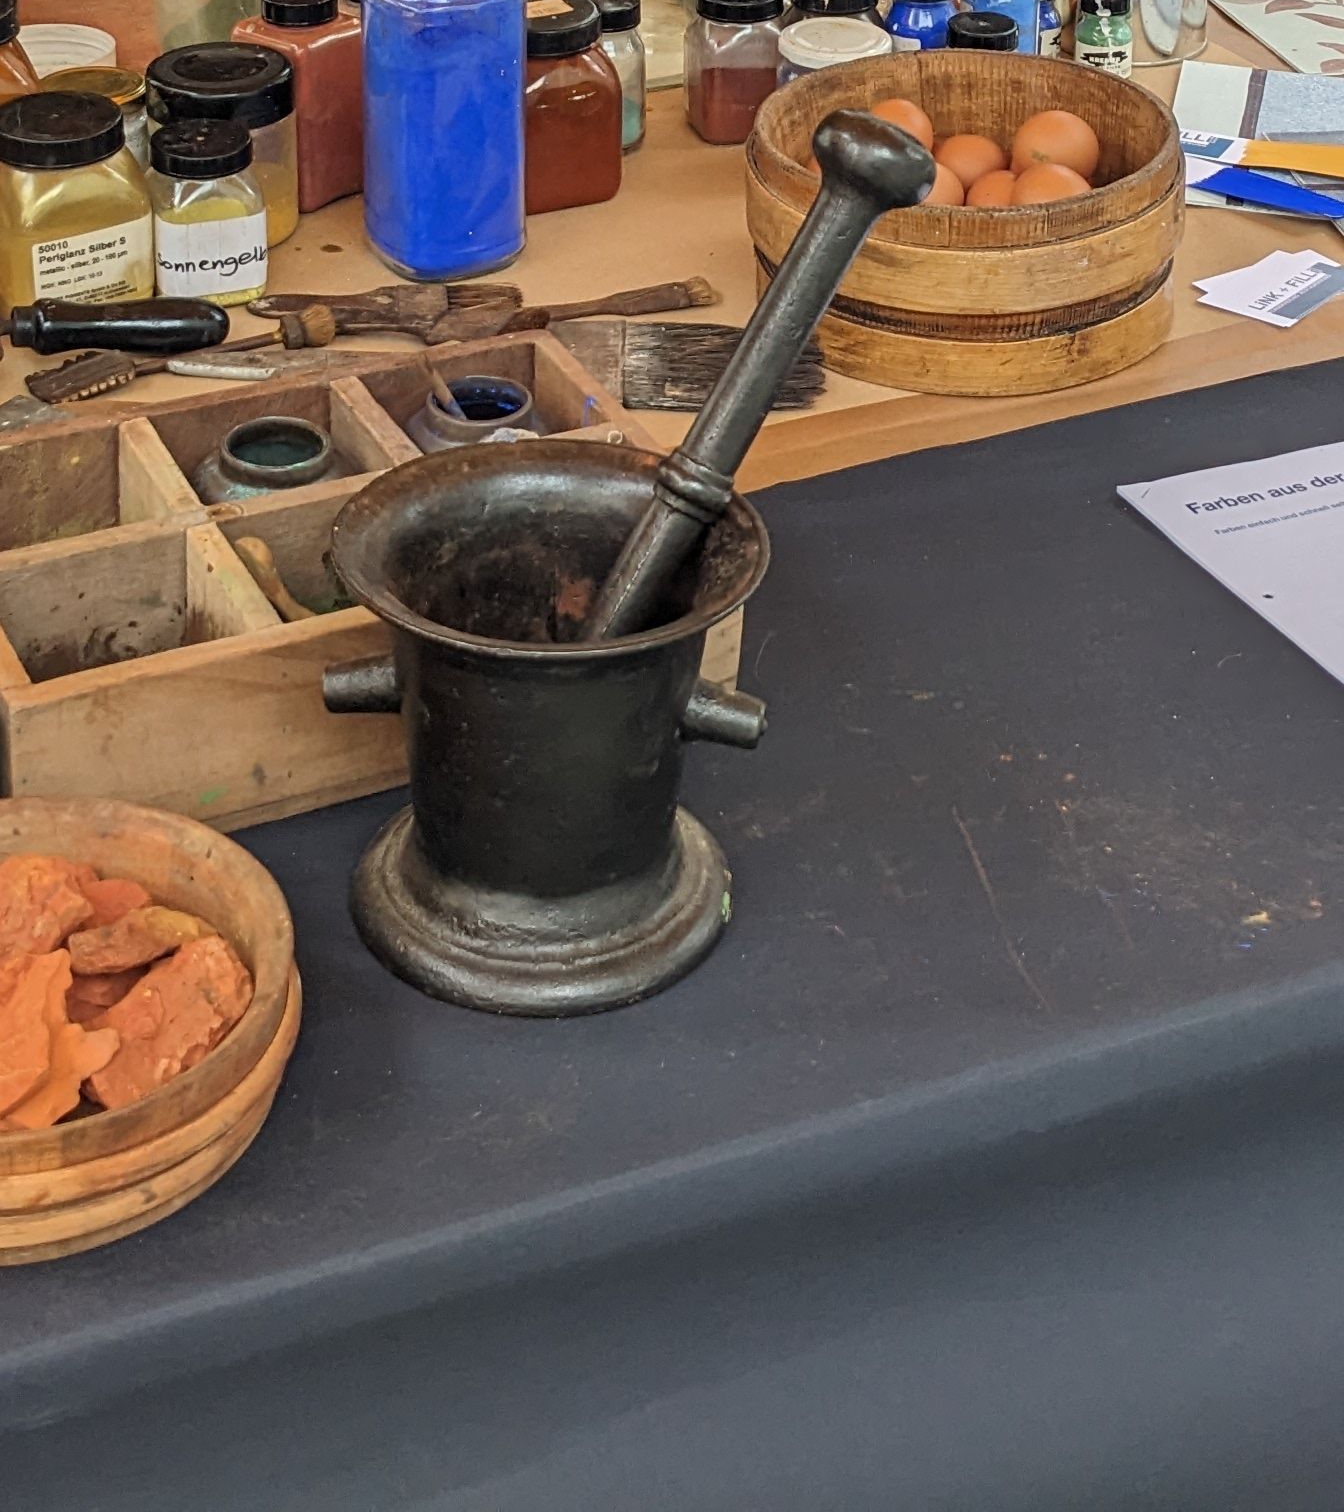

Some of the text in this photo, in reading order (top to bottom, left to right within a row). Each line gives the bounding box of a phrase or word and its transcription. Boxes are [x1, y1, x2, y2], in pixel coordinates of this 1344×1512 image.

[38, 239, 69, 255] 50010
[87, 239, 118, 255] Silber
[119, 236, 127, 246] S
[1185, 489, 1265, 515] Farben
[1268, 482, 1308, 499] aus
[1310, 471, 1344, 490] der
[1213, 522, 1247, 536] Farben
[1280, 510, 1298, 522] und
